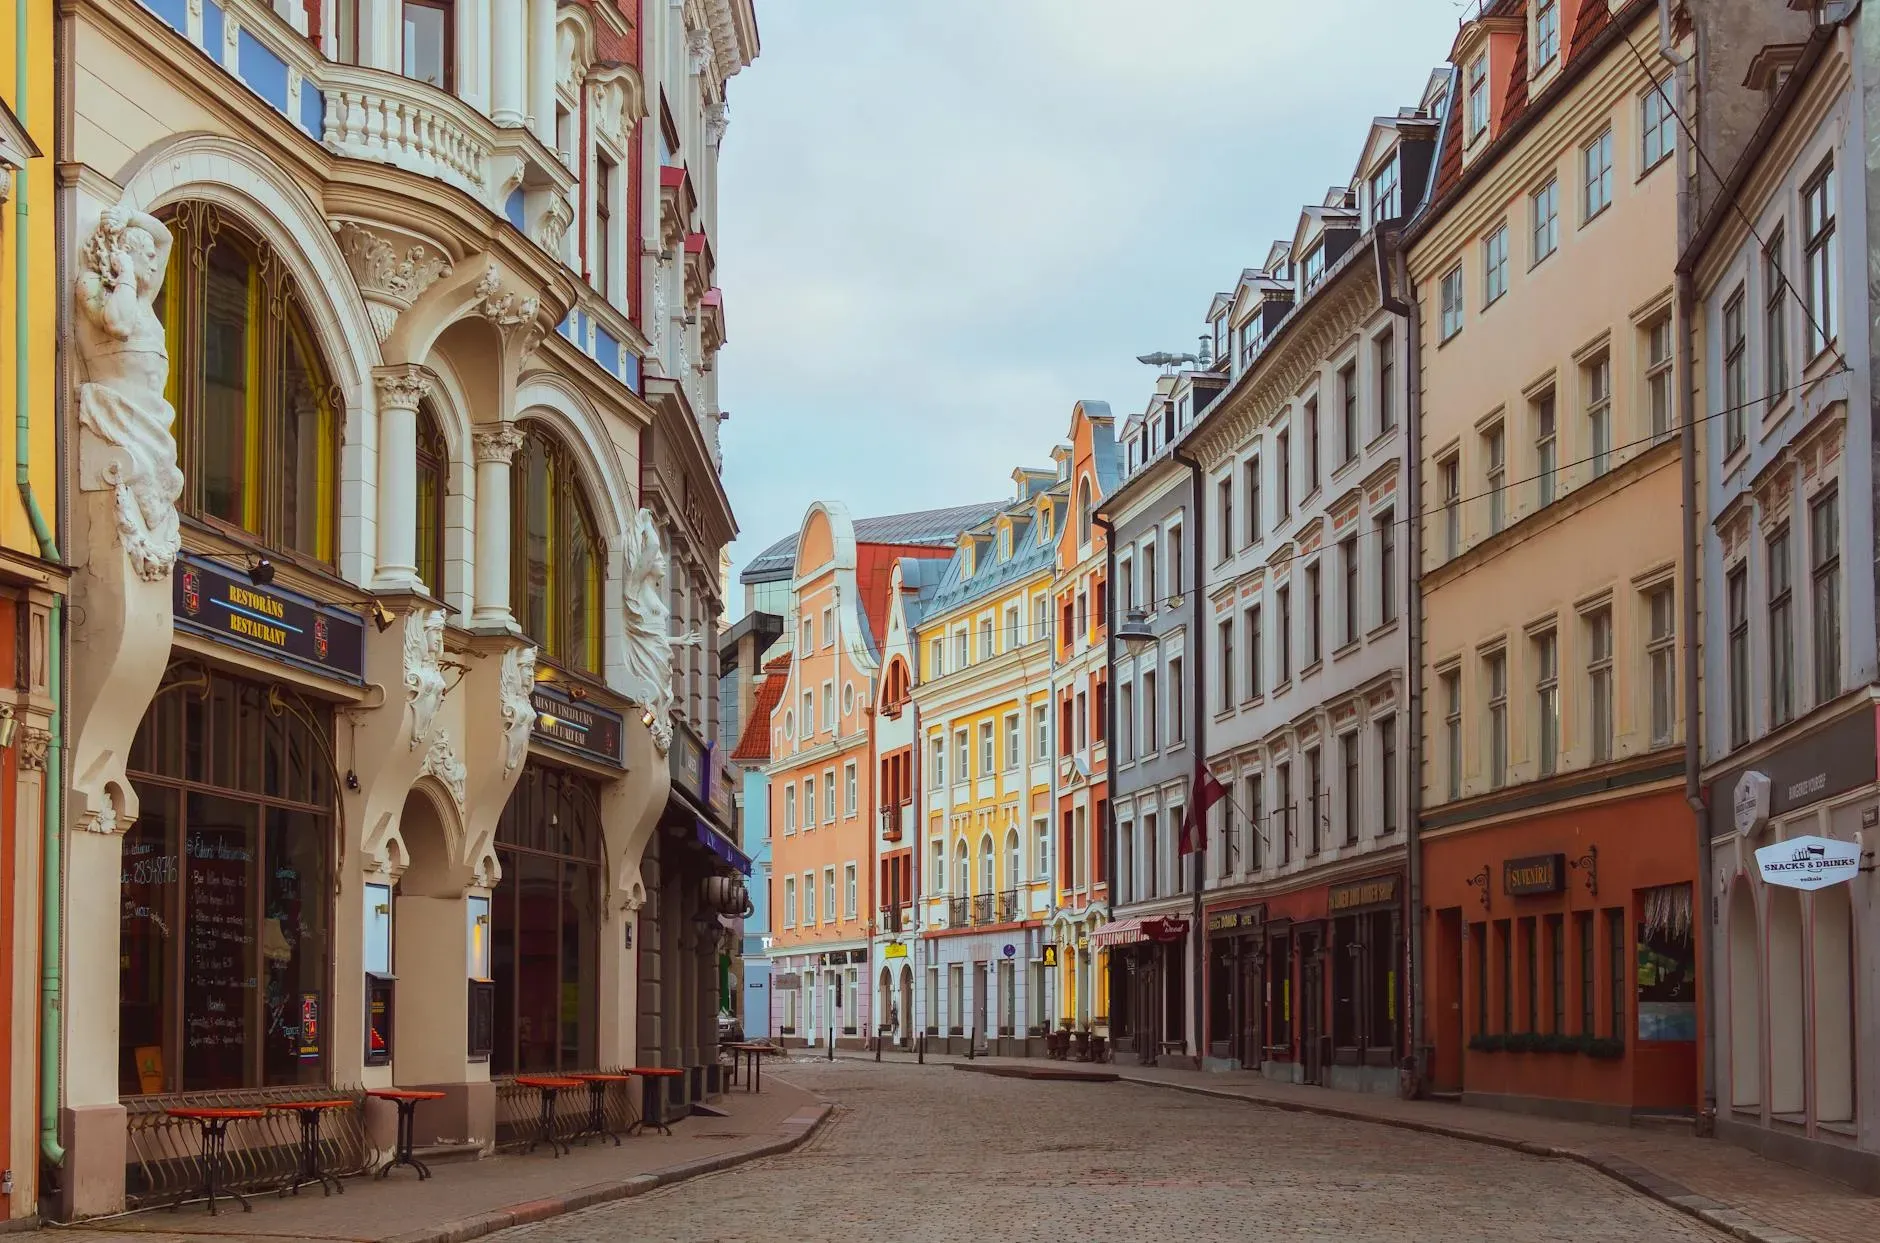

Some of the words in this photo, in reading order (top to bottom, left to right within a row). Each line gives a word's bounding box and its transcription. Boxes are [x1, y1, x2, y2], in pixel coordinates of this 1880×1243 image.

[230, 585, 284, 618] RESTORĀNS
[231, 614, 286, 646] RESTAURANT
[1764, 861, 1805, 872] SNACKS
[1808, 861, 1814, 869] &
[1816, 858, 1856, 868] DRINKS
